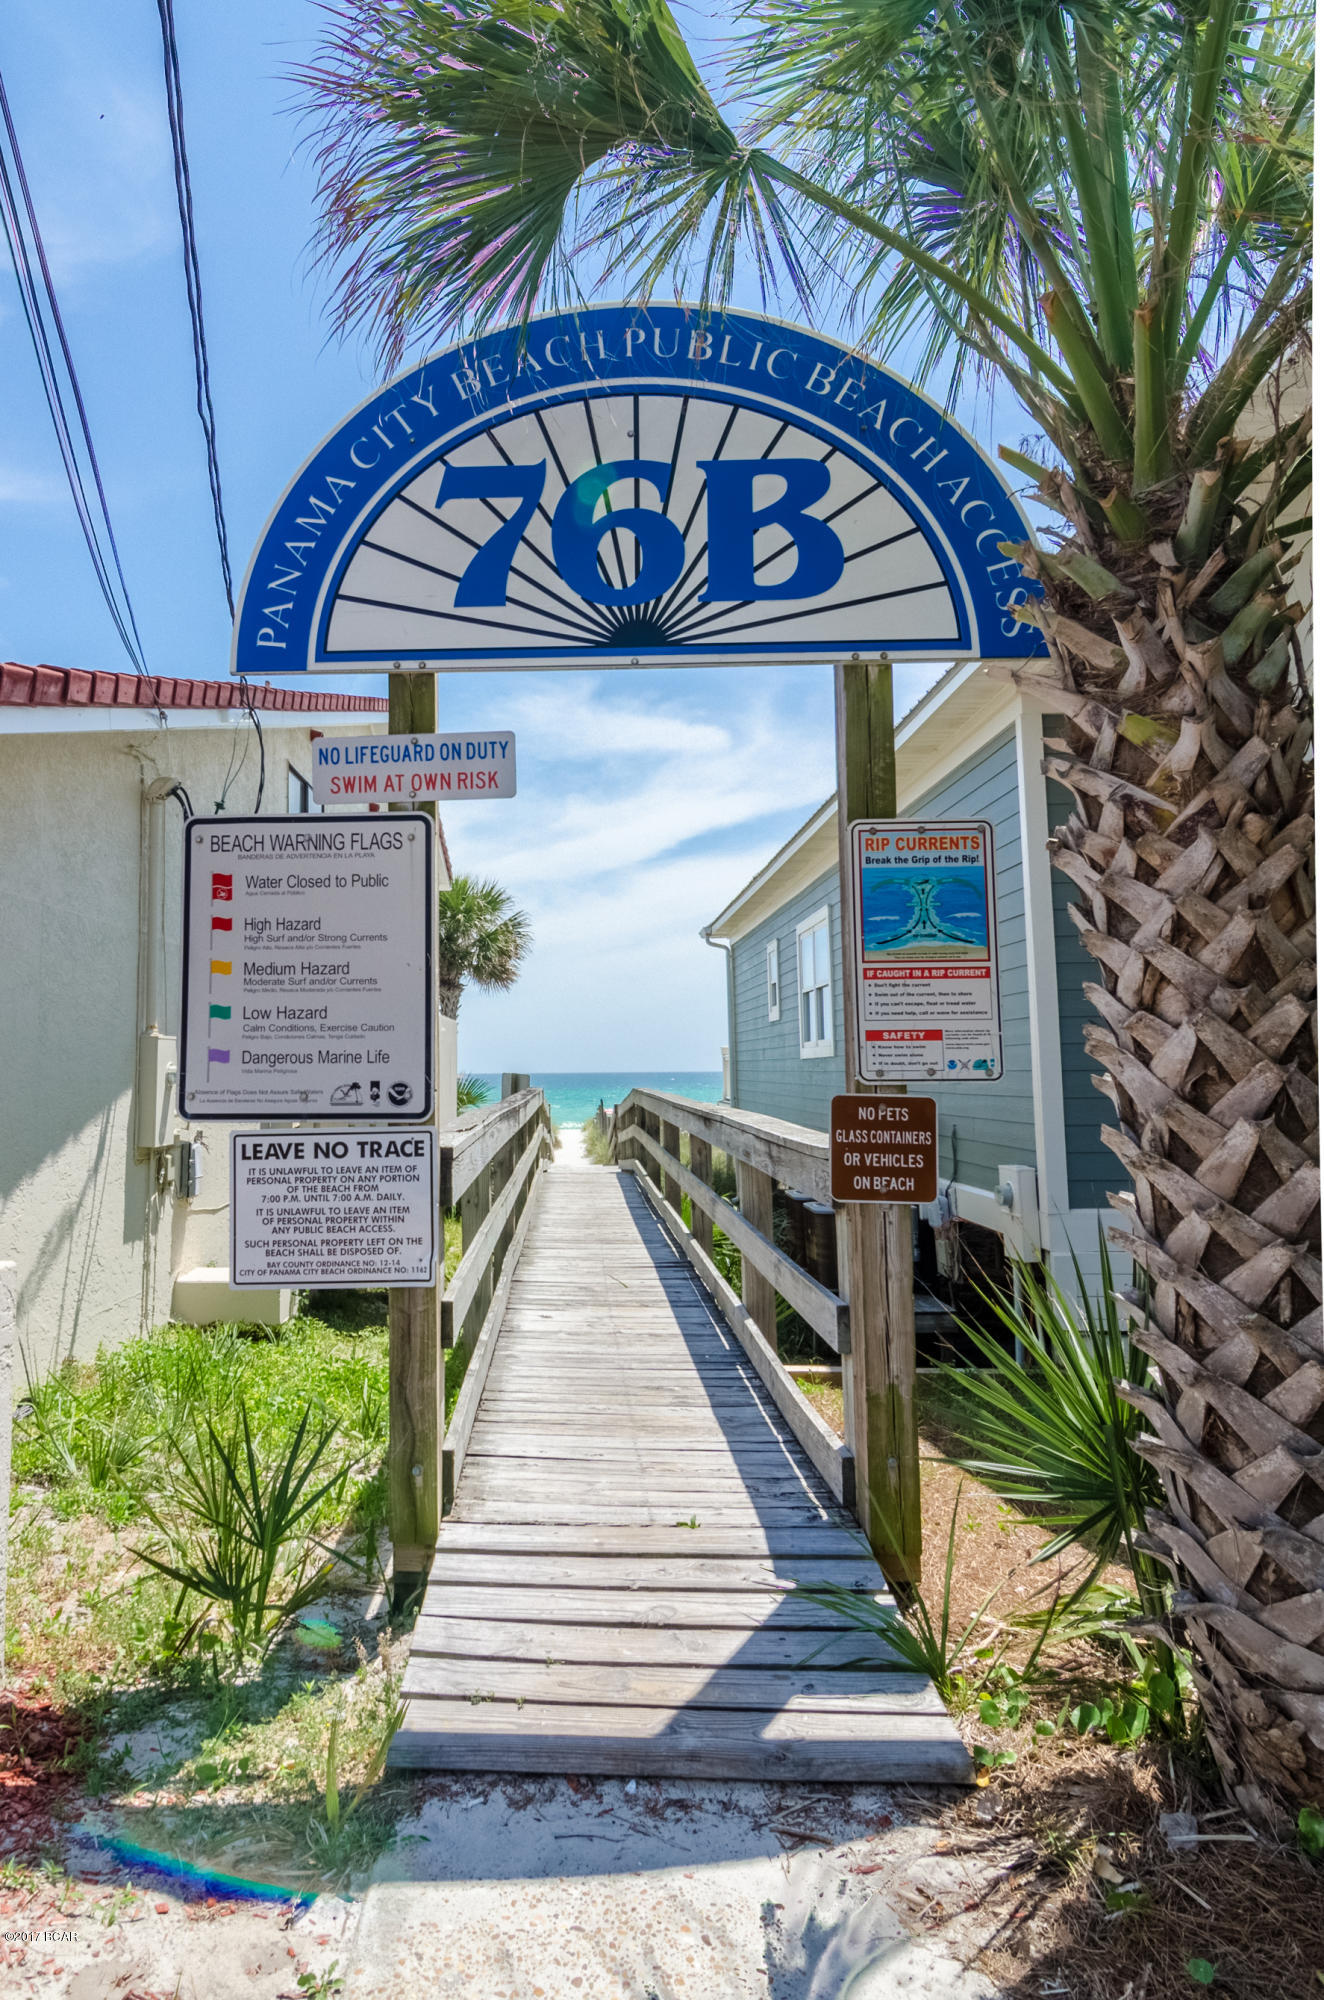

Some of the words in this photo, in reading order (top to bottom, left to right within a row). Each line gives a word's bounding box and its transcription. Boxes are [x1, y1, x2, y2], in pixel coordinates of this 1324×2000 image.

[256, 475, 357, 649] PANAMA
[349, 386, 440, 469] CITY
[451, 329, 605, 400] BEACH
[624, 327, 798, 379] PUBLIC
[804, 362, 949, 473] BEACH
[937, 476, 1034, 638] ACCESS
[435, 457, 844, 607] 76B
[319, 747, 340, 765] NO
[345, 744, 435, 764] LIFEGUARD
[440, 743, 461, 760] ON
[466, 741, 509, 760] DUTY
[330, 775, 377, 794] SWIM
[384, 774, 404, 792] AT
[411, 773, 450, 792] OWN
[457, 771, 499, 790] RISK
[210, 834, 265, 853] BEACH
[269, 832, 345, 851] WARNING
[350, 832, 403, 850] FLAGS
[865, 837, 890, 852] RIP
[895, 836, 980, 851] CURRENTS
[865, 856, 891, 864] Break
[895, 856, 910, 864] the
[912, 856, 930, 865] Grip
[933, 855, 942, 863] of
[945, 855, 959, 863] the
[962, 855, 979, 864] Rip!
[245, 875, 282, 888] Water
[286, 874, 331, 888] Closed
[336, 875, 347, 888] to
[352, 874, 389, 888] Public
[244, 918, 271, 934] High
[276, 917, 321, 931] Hazard
[244, 934, 263, 944] High
[266, 934, 284, 942] Surf
[288, 934, 315, 942] and/or
[318, 933, 347, 943] Strong
[350, 933, 388, 942] Currents
[243, 962, 296, 975] Medium
[301, 961, 350, 975] Hazard
[244, 978, 285, 986] Moderate
[288, 977, 306, 986] Surf
[309, 977, 337, 985] and/or
[340, 977, 378, 985] Currents
[243, 1006, 271, 1020] Low
[276, 1006, 327, 1019] Hazard
[243, 1024, 265, 1032] Calm
[268, 1024, 316, 1033] Conditions,
[320, 1023, 358, 1032] Exercise
[360, 1023, 395, 1032] Caution
[882, 1032, 925, 1040] SAFETY
[241, 1050, 314, 1068] Dangerous
[318, 1050, 362, 1064] Marine
[367, 1049, 390, 1063] Life
[858, 1107, 875, 1120] NO
[878, 1107, 909, 1121] PETS
[836, 1130, 868, 1143] GLASS
[870, 1130, 932, 1145] CONTAINERS
[241, 1142, 305, 1160] LEAVE
[314, 1141, 348, 1159] NO
[357, 1140, 425, 1158] TRACE
[844, 1153, 861, 1166] OR
[864, 1153, 924, 1168] VEHICLES
[248, 1168, 257, 1176] IT
[259, 1167, 267, 1175] IS
[269, 1166, 319, 1175] UNLAWFUL
[320, 1166, 333, 1174] TO
[336, 1166, 363, 1174] LEAVE
[365, 1166, 379, 1174] AN
[381, 1165, 402, 1173] ITEM
[404, 1165, 417, 1173] OF
[246, 1176, 292, 1185] PERSONAL
[294, 1176, 337, 1184] PROPERTY
[340, 1175, 354, 1183] ON
[358, 1175, 376, 1183] ANY
[380, 1174, 420, 1182] PORTION
[854, 1176, 870, 1190] ON
[873, 1176, 914, 1191] BEACH
[287, 1186, 299, 1194] OF
[302, 1185, 318, 1193] THE
[320, 1185, 350, 1193] BEACH
[353, 1184, 379, 1192] FROM
[262, 1195, 280, 1203] 7:00
[304, 1194, 330, 1202] UNTIL
[332, 1194, 352, 1202] 7:00
[354, 1193, 373, 1201] A.M.
[376, 1193, 405, 1201] DAILY.
[256, 1208, 265, 1216] IT
[266, 1208, 274, 1216] IS
[276, 1208, 326, 1216] UNLAWFUL
[328, 1207, 341, 1215] TO
[373, 1206, 387, 1214] AN
[389, 1206, 410, 1214] ITEM
[262, 1217, 275, 1225] OF
[277, 1217, 322, 1225] PERSONAL
[325, 1216, 368, 1224] PROPERTY
[272, 1226, 291, 1234] ANY
[294, 1226, 324, 1234] PUBLIC
[326, 1225, 356, 1233] BEACH
[359, 1225, 395, 1233] ACCESS.
[245, 1240, 270, 1248] SUCH
[272, 1240, 318, 1248] PERSONAL
[321, 1239, 364, 1247] PROPERTY
[366, 1238, 386, 1246] LEFT
[388, 1238, 403, 1246] ON
[265, 1249, 295, 1257] BEACH
[297, 1249, 325, 1257] SHALL
[327, 1248, 338, 1256] BE
[340, 1248, 384, 1256] DISPOSED
[387, 1247, 401, 1255] OF.
[316, 1260, 361, 1268] ORDINANCE
[269, 1268, 301, 1276] PANAMA
